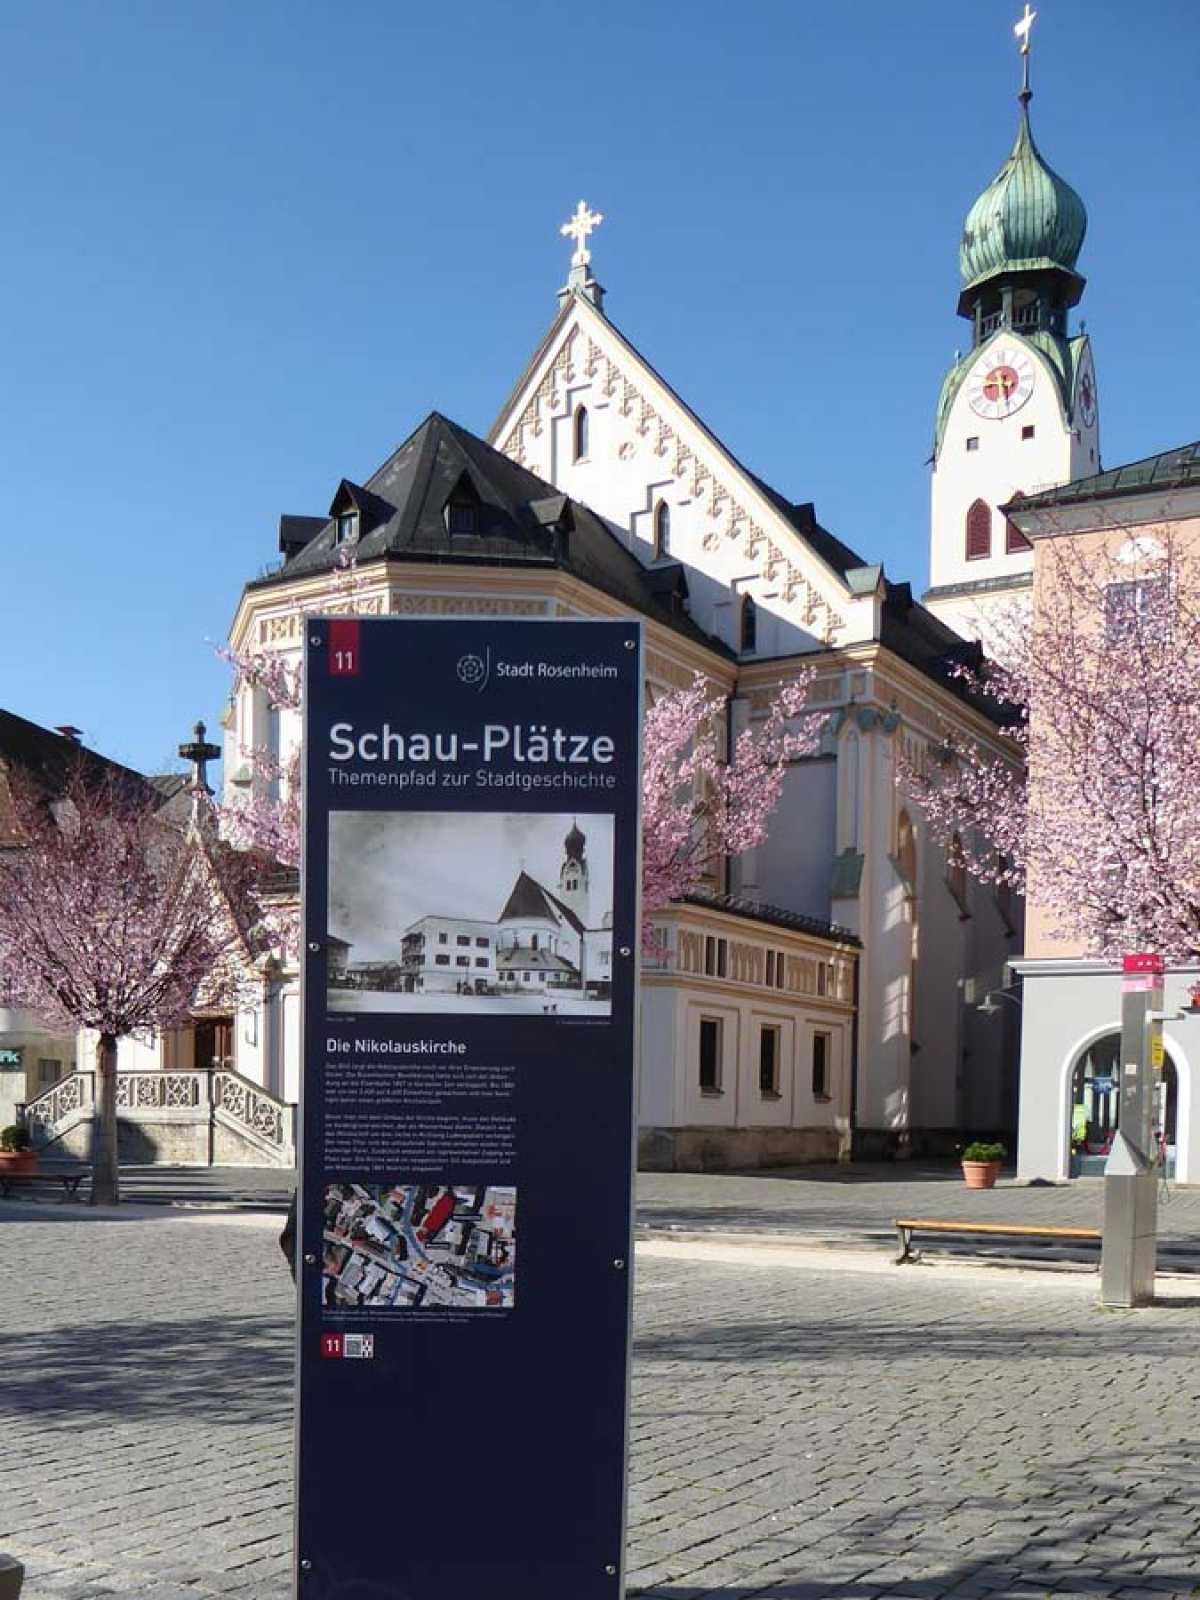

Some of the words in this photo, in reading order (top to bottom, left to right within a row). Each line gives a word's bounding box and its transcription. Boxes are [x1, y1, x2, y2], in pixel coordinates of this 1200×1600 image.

[335, 650, 353, 670] 11
[496, 662, 534, 678] Stadt
[537, 663, 618, 679] Rosenheim
[328, 722, 615, 763] Schau-Plätze
[328, 767, 437, 790] Themenpfad
[441, 771, 469, 787] zur
[475, 768, 617, 792] Stadtgeschichte
[325, 1038, 351, 1053] Die
[354, 1038, 467, 1055] Nikolauskirche
[325, 1339, 340, 1352] 11
